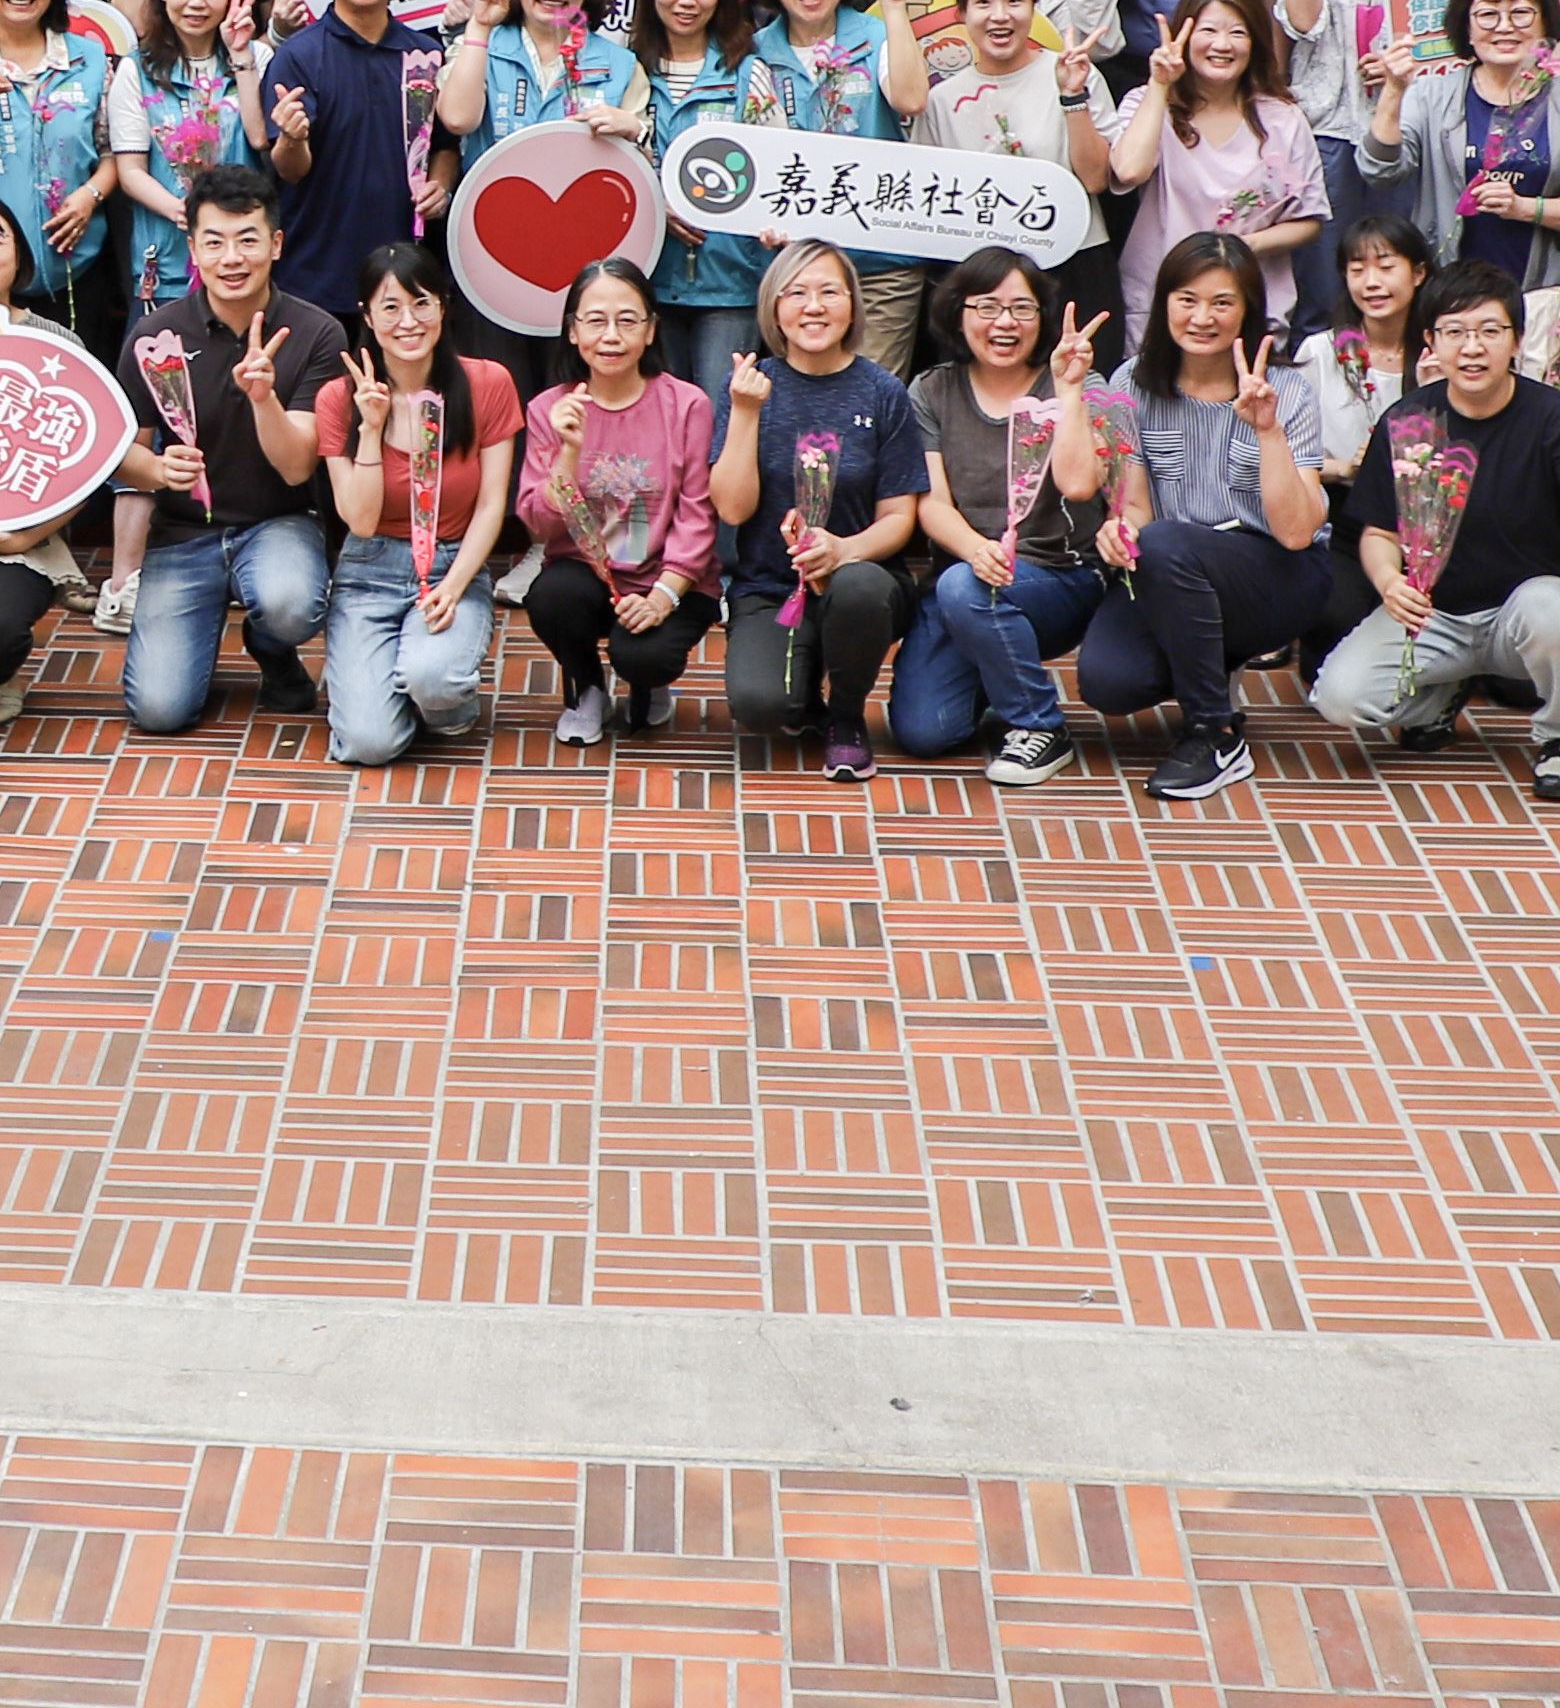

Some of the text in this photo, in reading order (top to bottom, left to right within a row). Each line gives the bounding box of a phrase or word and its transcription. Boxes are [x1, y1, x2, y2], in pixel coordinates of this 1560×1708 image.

[760, 153, 1057, 232] 嘉義縣社會局
[871, 216, 1056, 249] Social Affairs Bureau of Chiayi County
